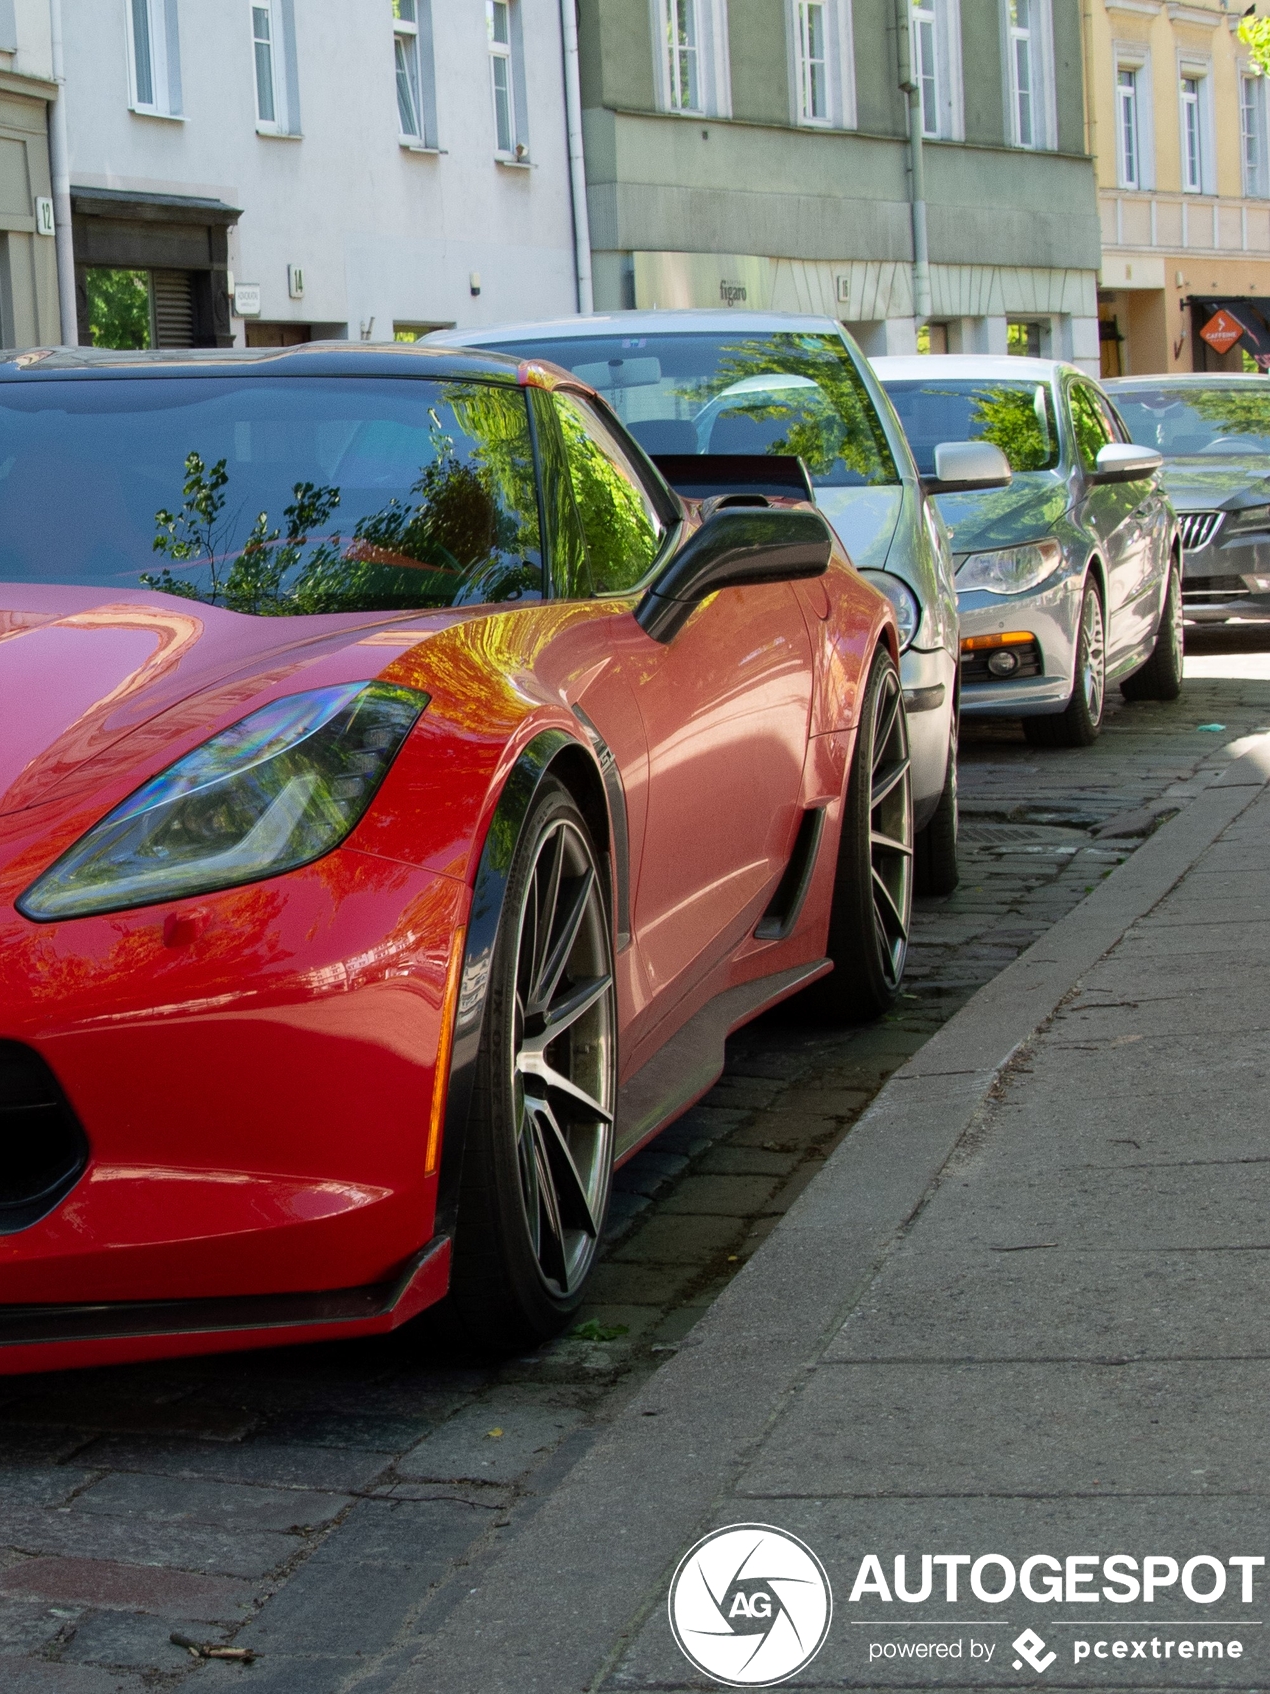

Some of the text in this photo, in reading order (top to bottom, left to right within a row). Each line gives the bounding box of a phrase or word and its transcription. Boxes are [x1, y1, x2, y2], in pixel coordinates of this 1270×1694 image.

[42, 202, 52, 230] 12
[294, 270, 303, 293] 14
[720, 279, 747, 307] figaro
[842, 280, 848, 298] 16
[1206, 331, 1237, 339] CAFFEINE
